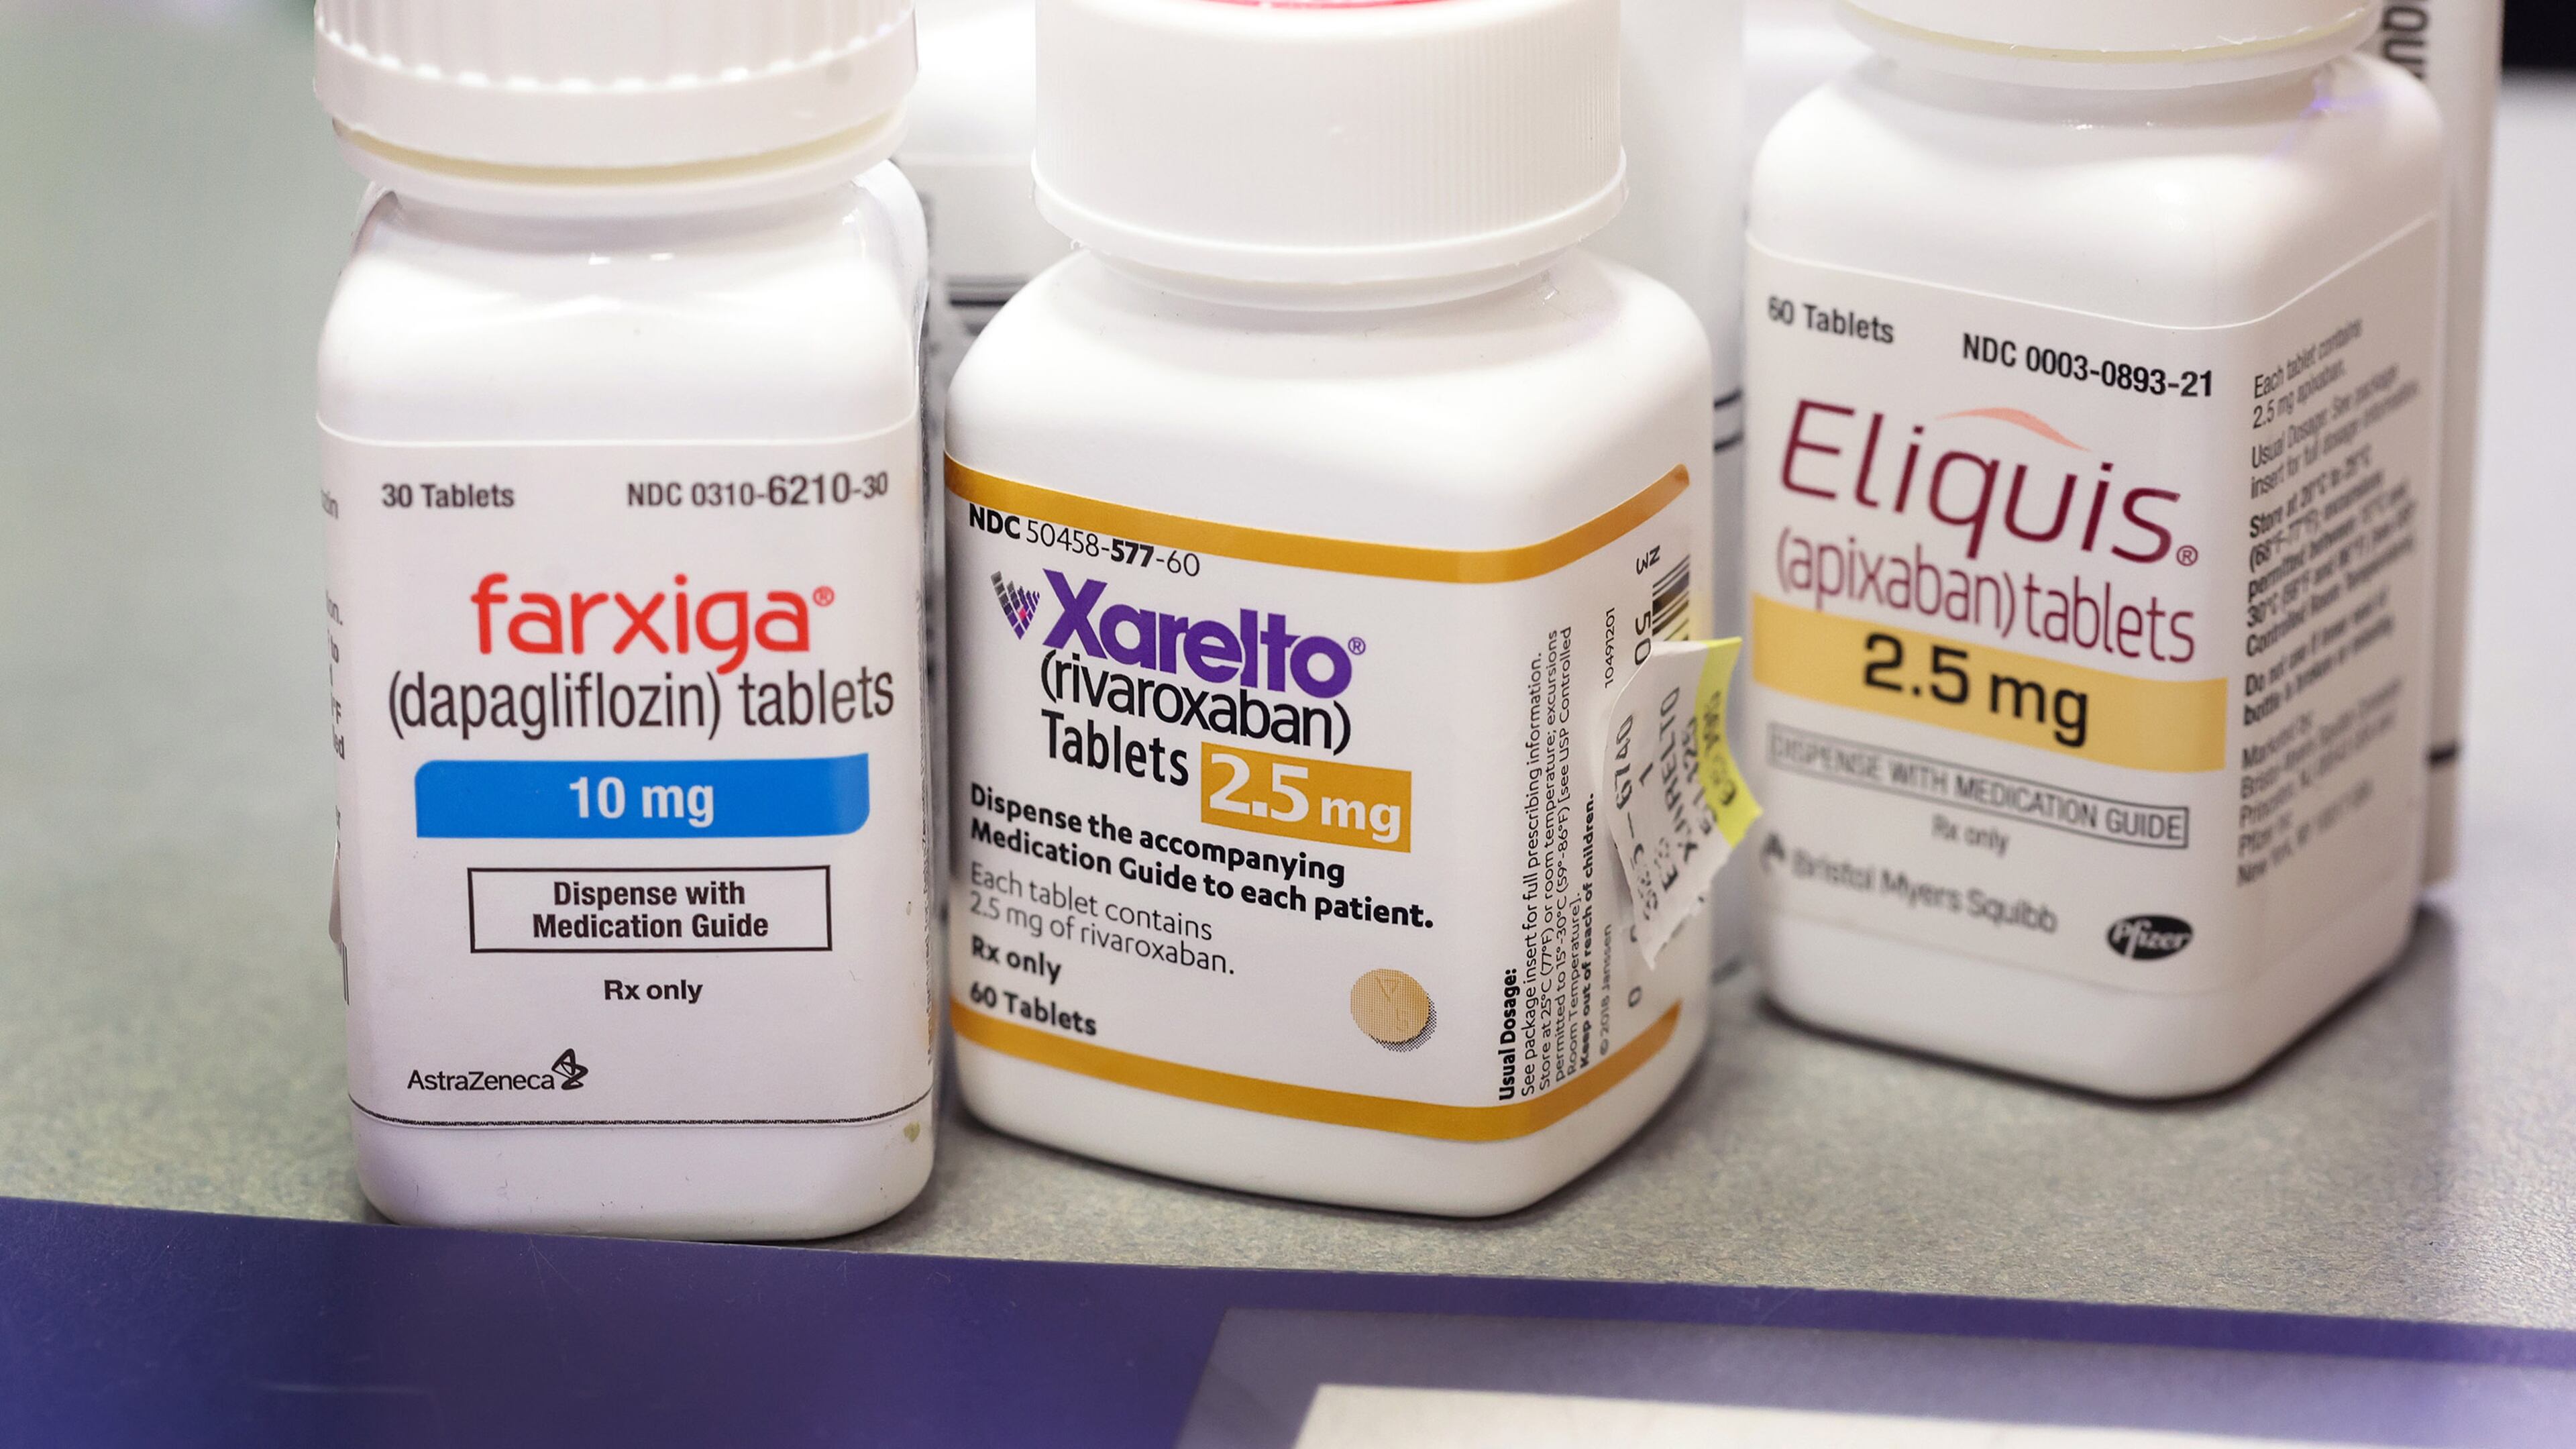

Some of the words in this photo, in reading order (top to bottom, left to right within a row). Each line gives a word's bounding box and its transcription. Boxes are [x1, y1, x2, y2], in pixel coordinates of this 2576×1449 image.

[1768, 296, 1794, 325] 60
[1803, 304, 1894, 343] Tablets
[1963, 333, 2016, 366] NDC
[2027, 345, 2213, 397] 0003-0893-21
[2253, 399, 2275, 429] 2.5
[382, 484, 413, 508] 30
[421, 484, 515, 509] Tablets
[628, 483, 682, 507] NDC
[692, 472, 889, 507] 0310-6210-30
[969, 503, 1021, 539] NDC
[1026, 521, 1201, 577] 50458-577-60
[1777, 527, 2015, 639] (apixaban)
[2025, 571, 2195, 663] tablets
[1605, 607, 1615, 689] 10491201
[1546, 630, 1558, 725] excursions
[1559, 627, 1572, 722] Controlled
[1864, 632, 1970, 704] 2.5
[1989, 672, 2087, 748] mg
[388, 670, 722, 741] (dapagliflozin)
[739, 667, 894, 726] tablets
[1041, 649, 1351, 756] (rivaroxaban)
[1525, 653, 1542, 765] information.
[1559, 727, 1570, 761] USP
[1041, 709, 1189, 786] Tablets
[1208, 753, 1309, 822] 2.5
[1321, 791, 1401, 843] mg
[1544, 729, 1558, 848] temperature;
[1558, 765, 1571, 801] [see
[1891, 760, 1947, 793] WITH
[1955, 774, 2097, 829] MEDICATION
[2106, 807, 2181, 840] GUIDE
[570, 777, 626, 820] 10
[642, 784, 714, 829] mg
[1524, 768, 1542, 868] prescribing
[971, 783, 1082, 833] Dispense
[1088, 814, 1133, 845] the
[1140, 831, 1345, 888] accompanying
[1583, 794, 1594, 878] children.
[1933, 814, 1957, 839] Rx
[1964, 825, 2009, 859] only
[553, 881, 678, 910] Dispense
[686, 881, 745, 906] with
[971, 819, 1112, 875] Medication
[1119, 857, 1197, 893] Guide
[1204, 873, 1234, 898] to
[1240, 882, 1307, 912] each
[1315, 896, 1434, 929] patient.
[1523, 874, 1538, 900] full
[1544, 852, 1554, 898] room
[1582, 881, 1593, 902] of
[533, 912, 682, 938] Medication
[692, 912, 769, 938] Guide
[971, 863, 1022, 898] Each
[1029, 879, 1098, 917] tablet
[1106, 900, 1213, 941] contains
[1523, 905, 1538, 929] for
[1544, 905, 1553, 923] or
[1880, 869, 1962, 912] Myers
[1966, 886, 2058, 935] Squibb
[970, 893, 1000, 920] 2.5
[1006, 909, 1042, 937] mg
[1049, 916, 1076, 940] of
[1081, 924, 1235, 975] rivaroxaban.
[1542, 928, 1554, 975] (77°F)
[1568, 892, 1581, 1019] Temperature].
[1582, 907, 1592, 956] reach
[2112, 917, 2194, 959] Pfizer
[971, 936, 1000, 963] Rx
[1006, 944, 1061, 983] only
[1523, 933, 1537, 982] insert
[1556, 971, 1566, 991] to
[1580, 960, 1591, 979] of
[1602, 924, 1612, 991] Janssen
[604, 980, 641, 1001] Rx
[646, 979, 703, 1004] only
[970, 981, 998, 1008] 60
[1004, 991, 1097, 1036] Tablets
[1501, 968, 1519, 1043] Dosage:
[1540, 979, 1552, 1019] 25°C
[1580, 983, 1591, 1016] out
[1521, 987, 1539, 1059] package
[1540, 1022, 1551, 1038] at
[1554, 995, 1566, 1082] permitted
[1580, 1020, 1591, 1068] Keep
[1540, 1042, 1551, 1091] Store
[1566, 1022, 1578, 1075] Room
[407, 1069, 555, 1091] AstraZeneca
[1499, 1049, 1515, 1100] Usual
[1521, 1065, 1535, 1096] See
